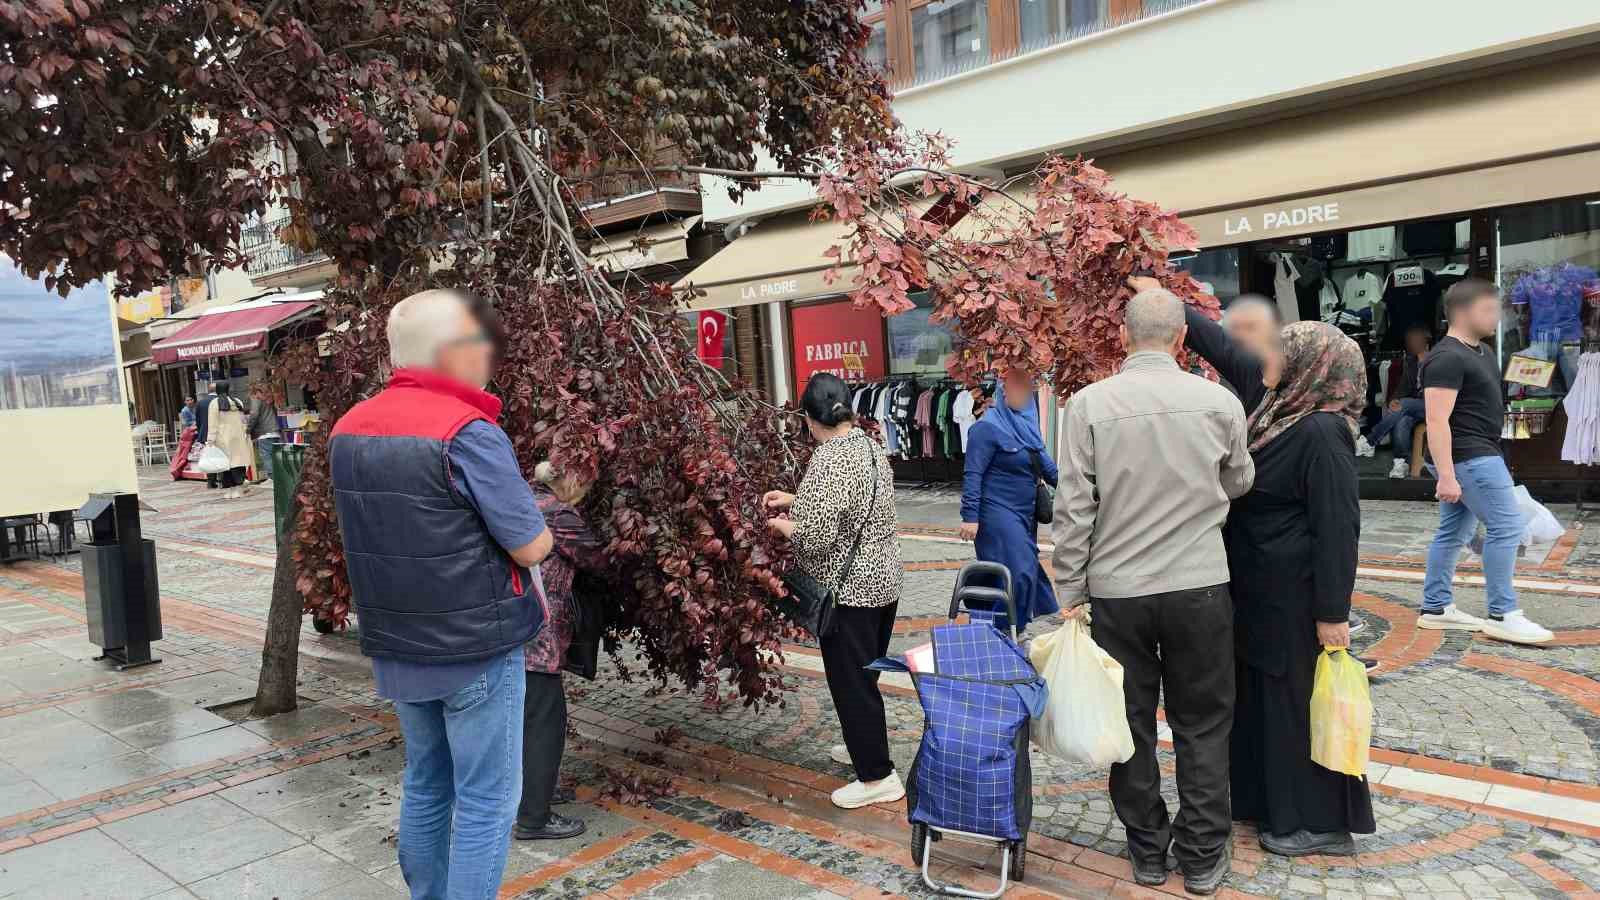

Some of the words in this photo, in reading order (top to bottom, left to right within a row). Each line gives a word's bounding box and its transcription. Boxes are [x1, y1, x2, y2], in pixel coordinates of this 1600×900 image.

[1224, 216, 1252, 236] LA
[1263, 202, 1340, 230] PADRE
[1396, 271, 1416, 282] 700
[741, 287, 757, 299] LA
[760, 280, 798, 297] PADRE
[805, 340, 869, 362] FABRICA
